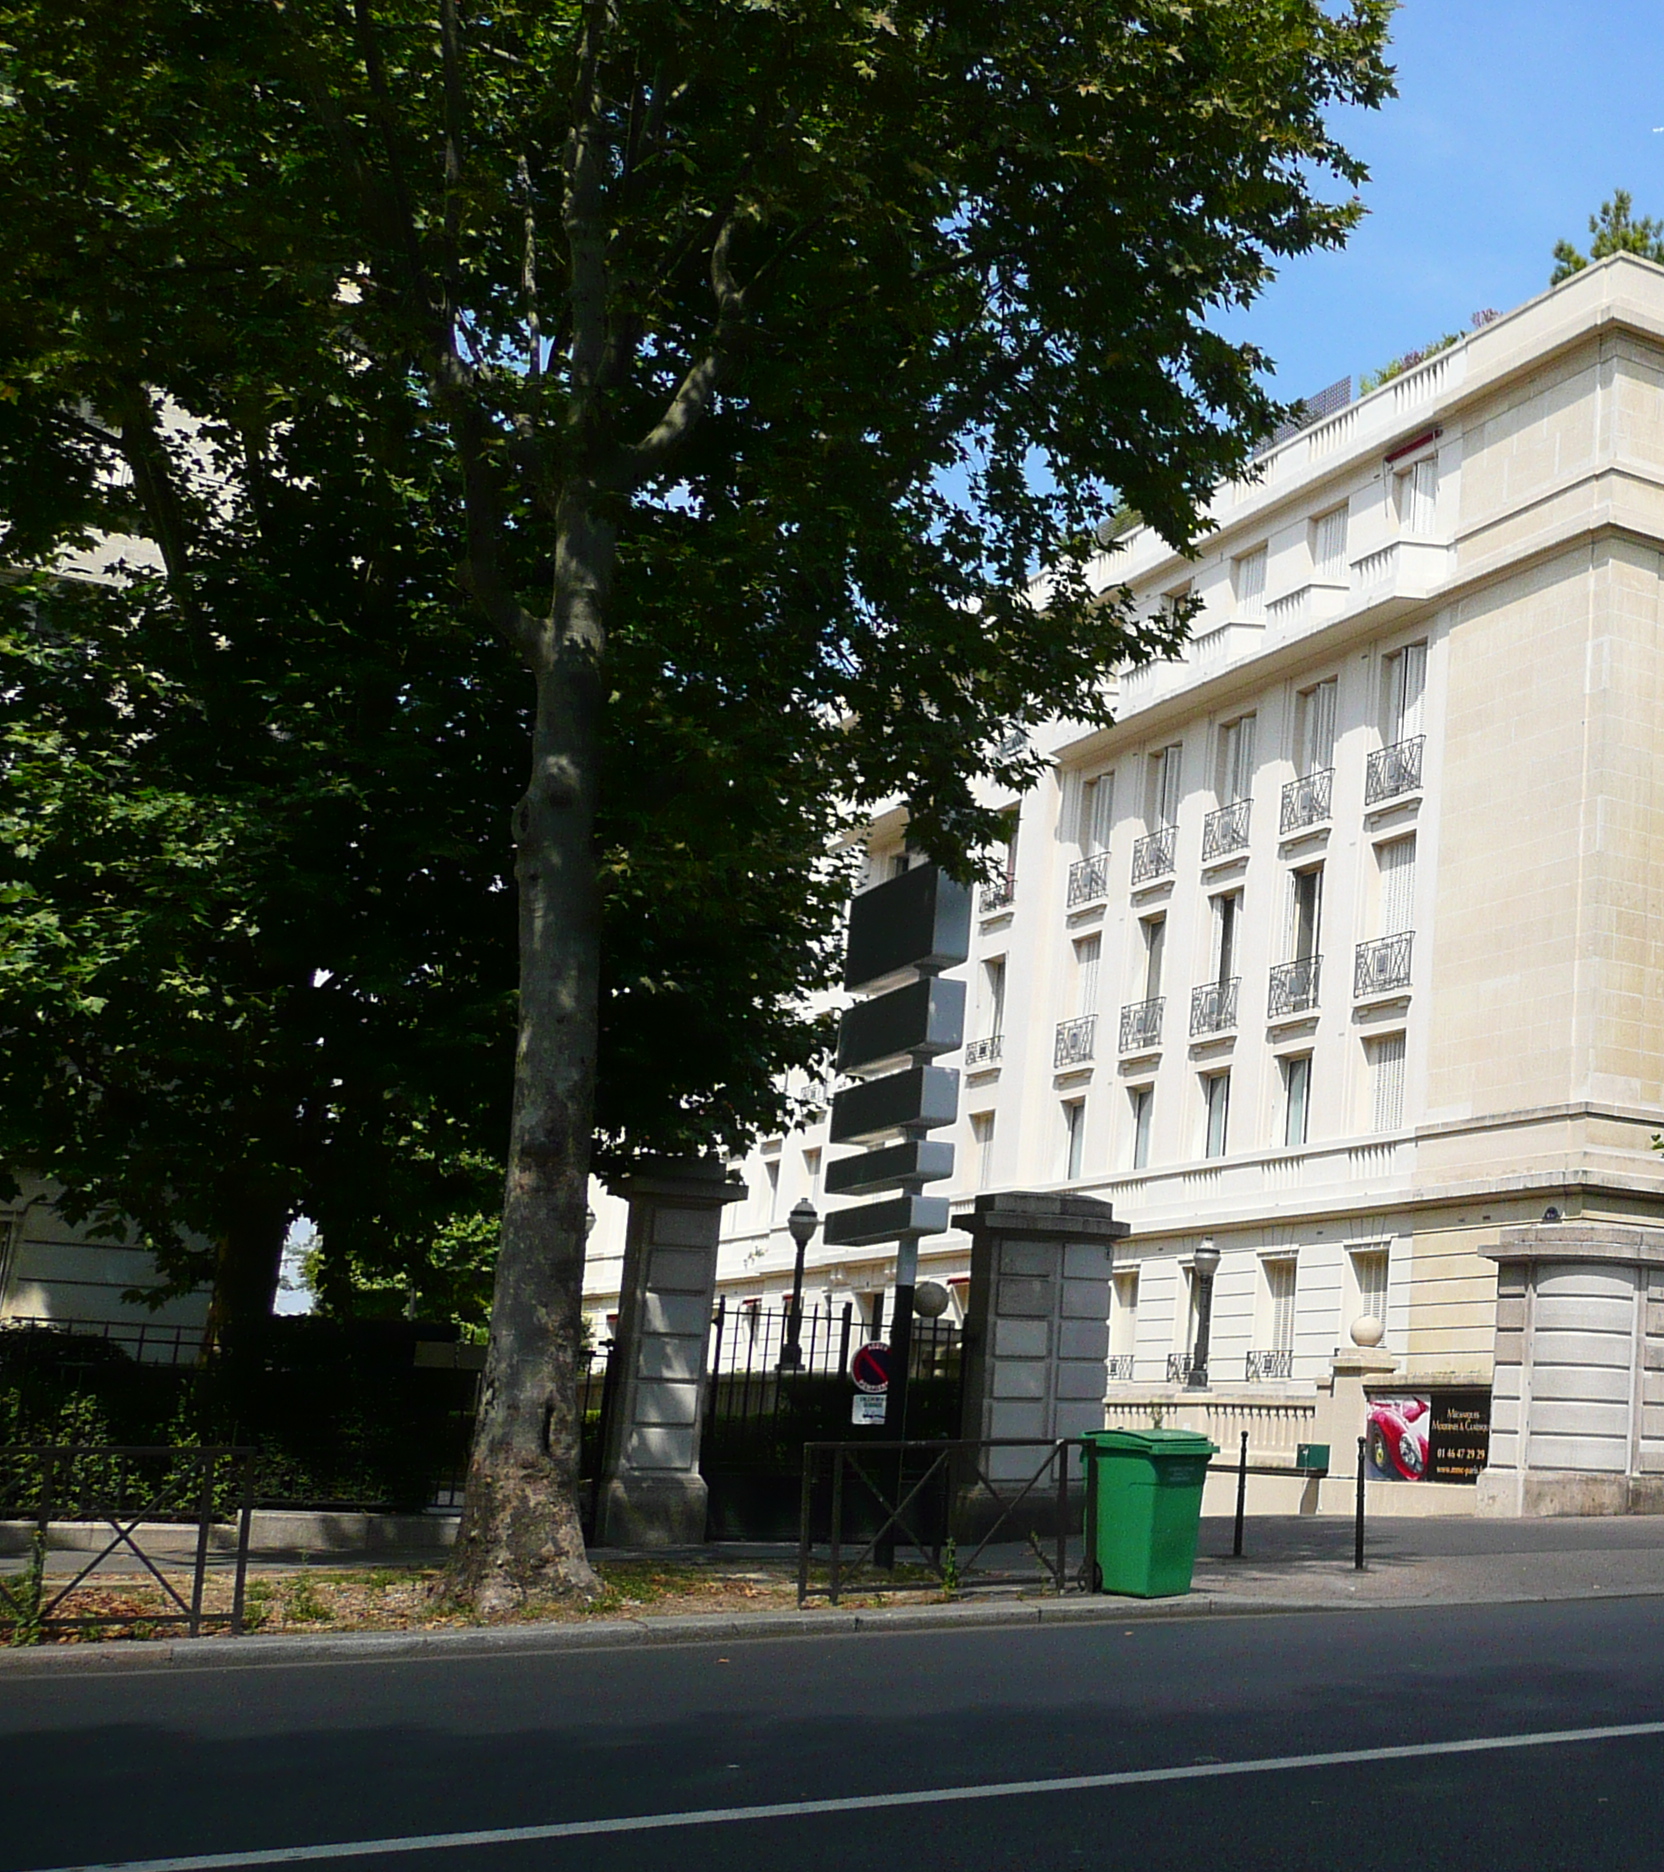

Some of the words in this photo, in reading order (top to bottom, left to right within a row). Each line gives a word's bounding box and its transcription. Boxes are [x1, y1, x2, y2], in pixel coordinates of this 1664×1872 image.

[1437, 1448, 1445, 1459] 01
[1447, 1448, 1455, 1459] 46
[1457, 1448, 1465, 1459] 47
[1467, 1449, 1475, 1460] 29
[1476, 1449, 1485, 1460] 29
